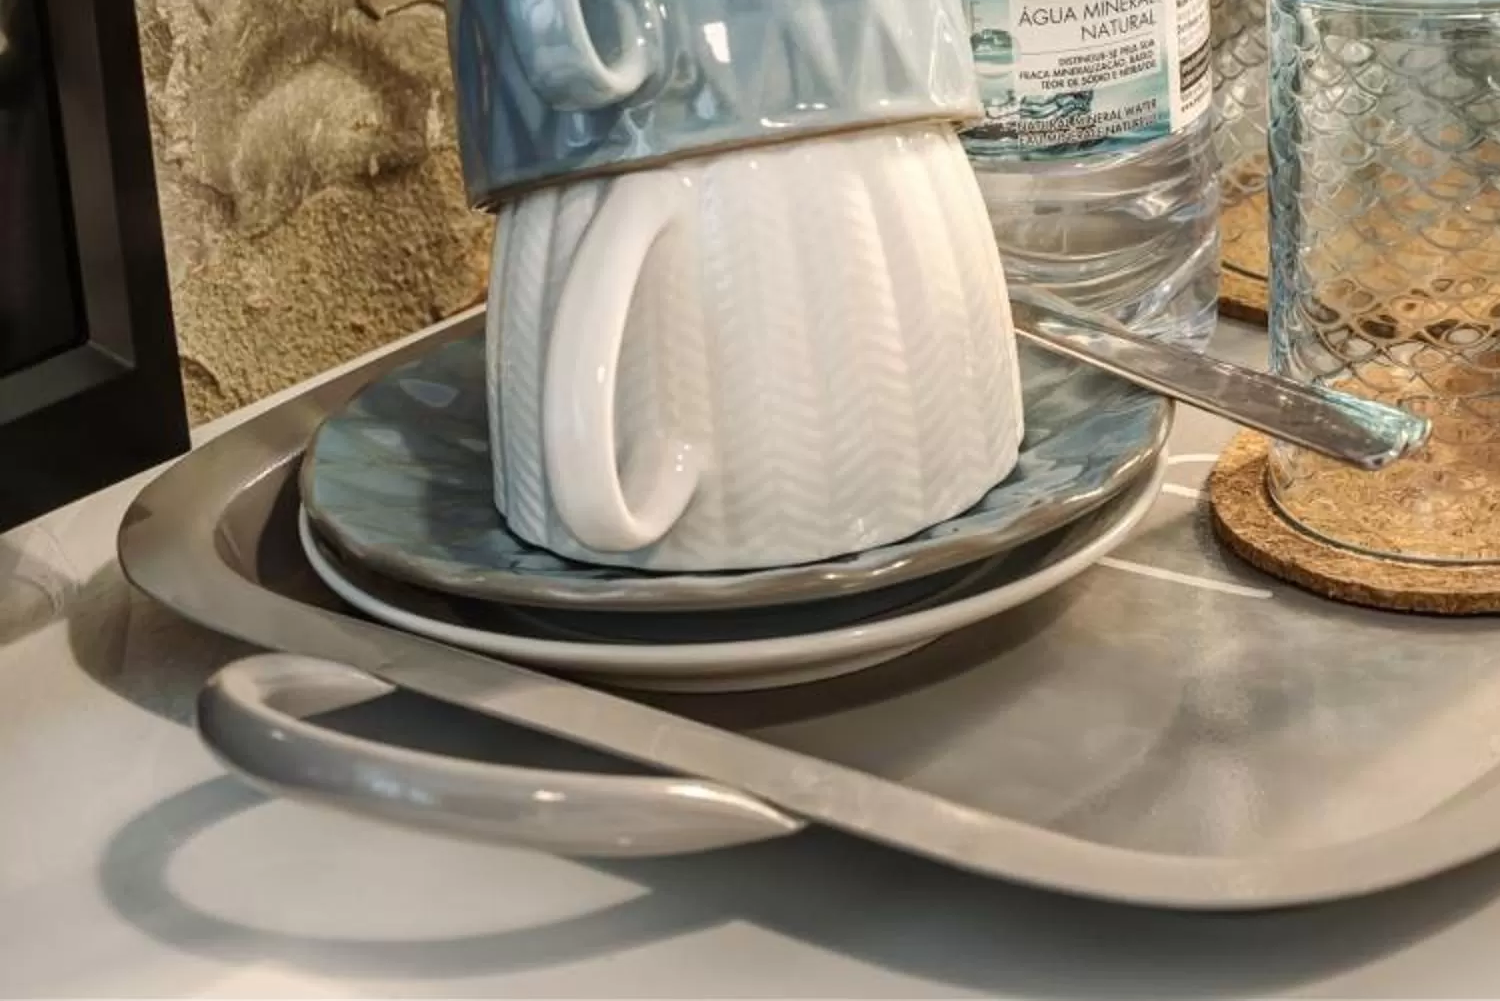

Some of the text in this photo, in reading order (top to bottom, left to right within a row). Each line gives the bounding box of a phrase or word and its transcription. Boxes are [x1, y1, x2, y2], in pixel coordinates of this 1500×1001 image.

[1018, 6, 1077, 27] ÁGUA
[1081, 9, 1157, 41] NATURAL
[1124, 98, 1157, 115] WATER
